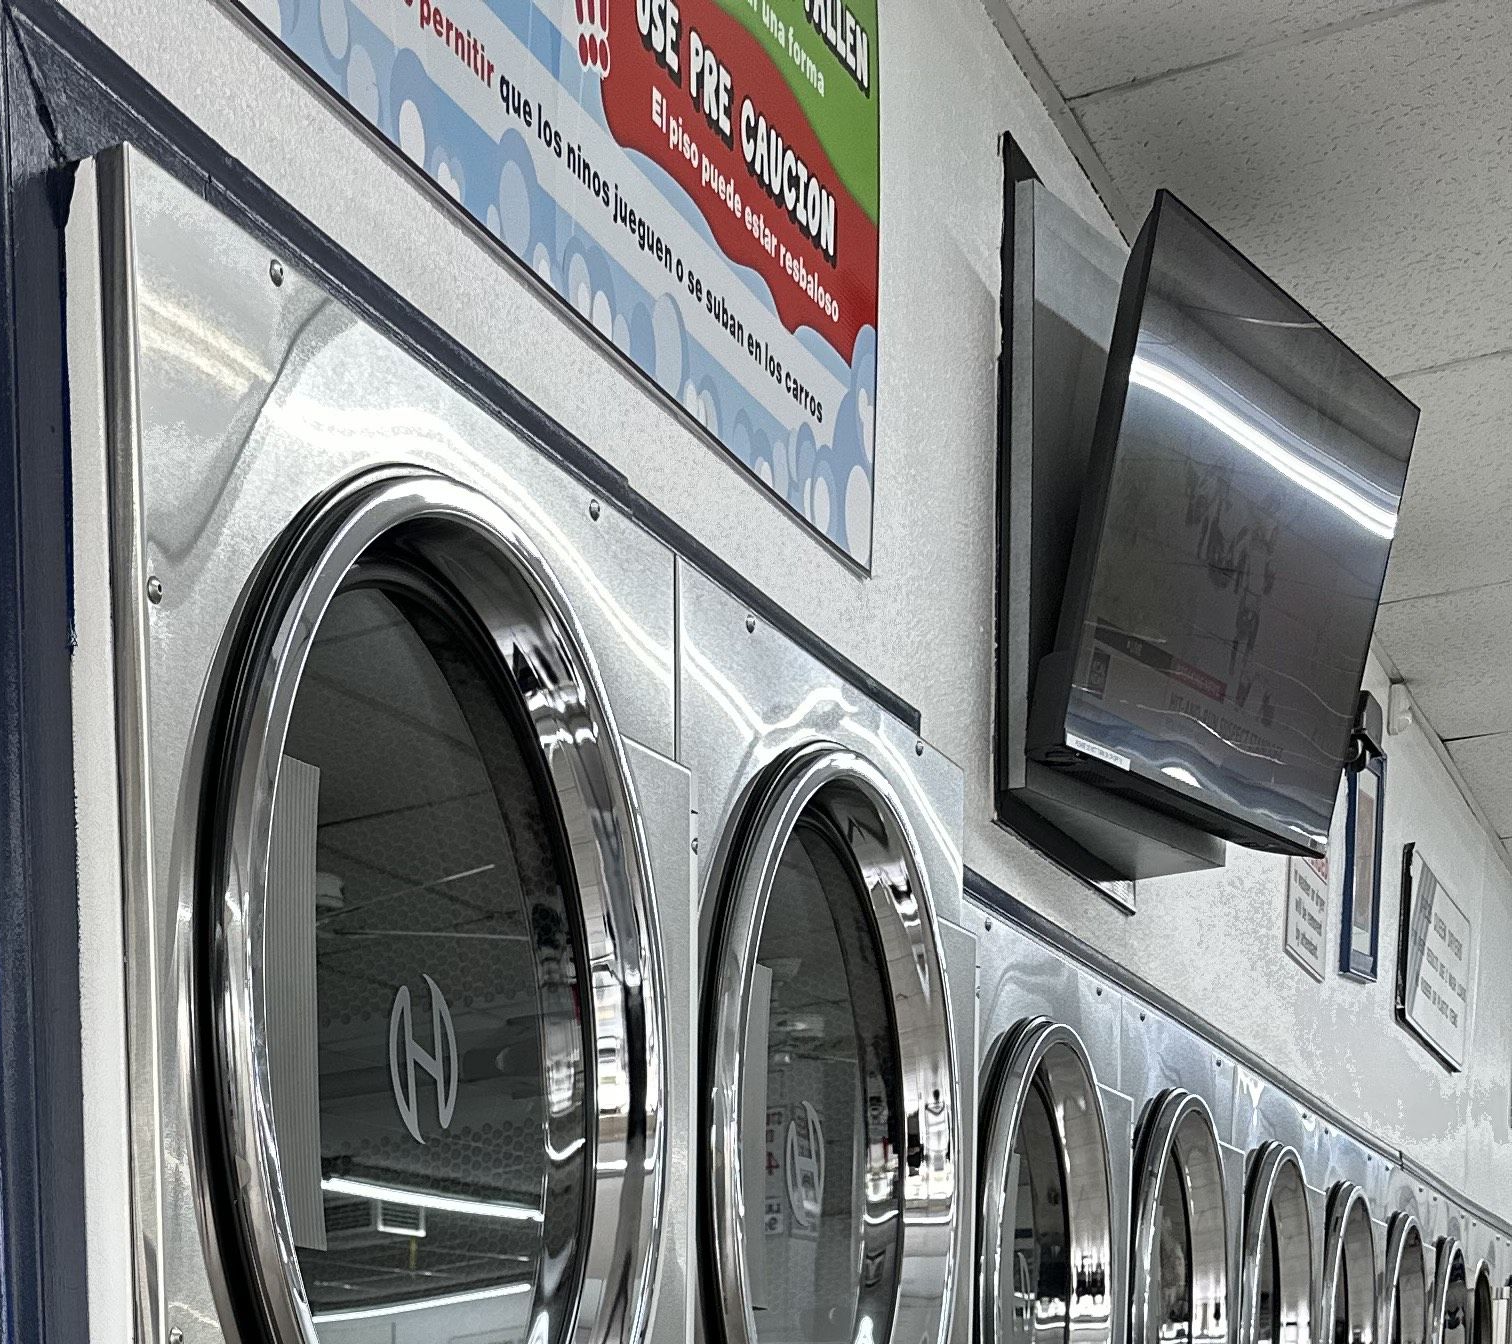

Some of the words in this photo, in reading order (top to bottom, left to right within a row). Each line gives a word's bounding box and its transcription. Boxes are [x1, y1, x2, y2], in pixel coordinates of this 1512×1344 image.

[689, 30, 732, 137] PRE
[740, 98, 835, 257] CAUCION
[788, 26, 825, 97] forma
[499, 74, 533, 128] que
[537, 103, 562, 158] los
[567, 141, 610, 207] ninos
[613, 182, 673, 274] jueguen
[675, 257, 684, 283] o
[687, 269, 703, 303] se
[705, 288, 744, 347] suban
[747, 332, 762, 365] en
[764, 342, 782, 384] los
[784, 370, 824, 424] carros
[652, 85, 666, 134] El
[669, 113, 699, 169] piso
[701, 152, 741, 219] puede
[745, 205, 777, 259] estar
[779, 243, 839, 323] resbaloso
